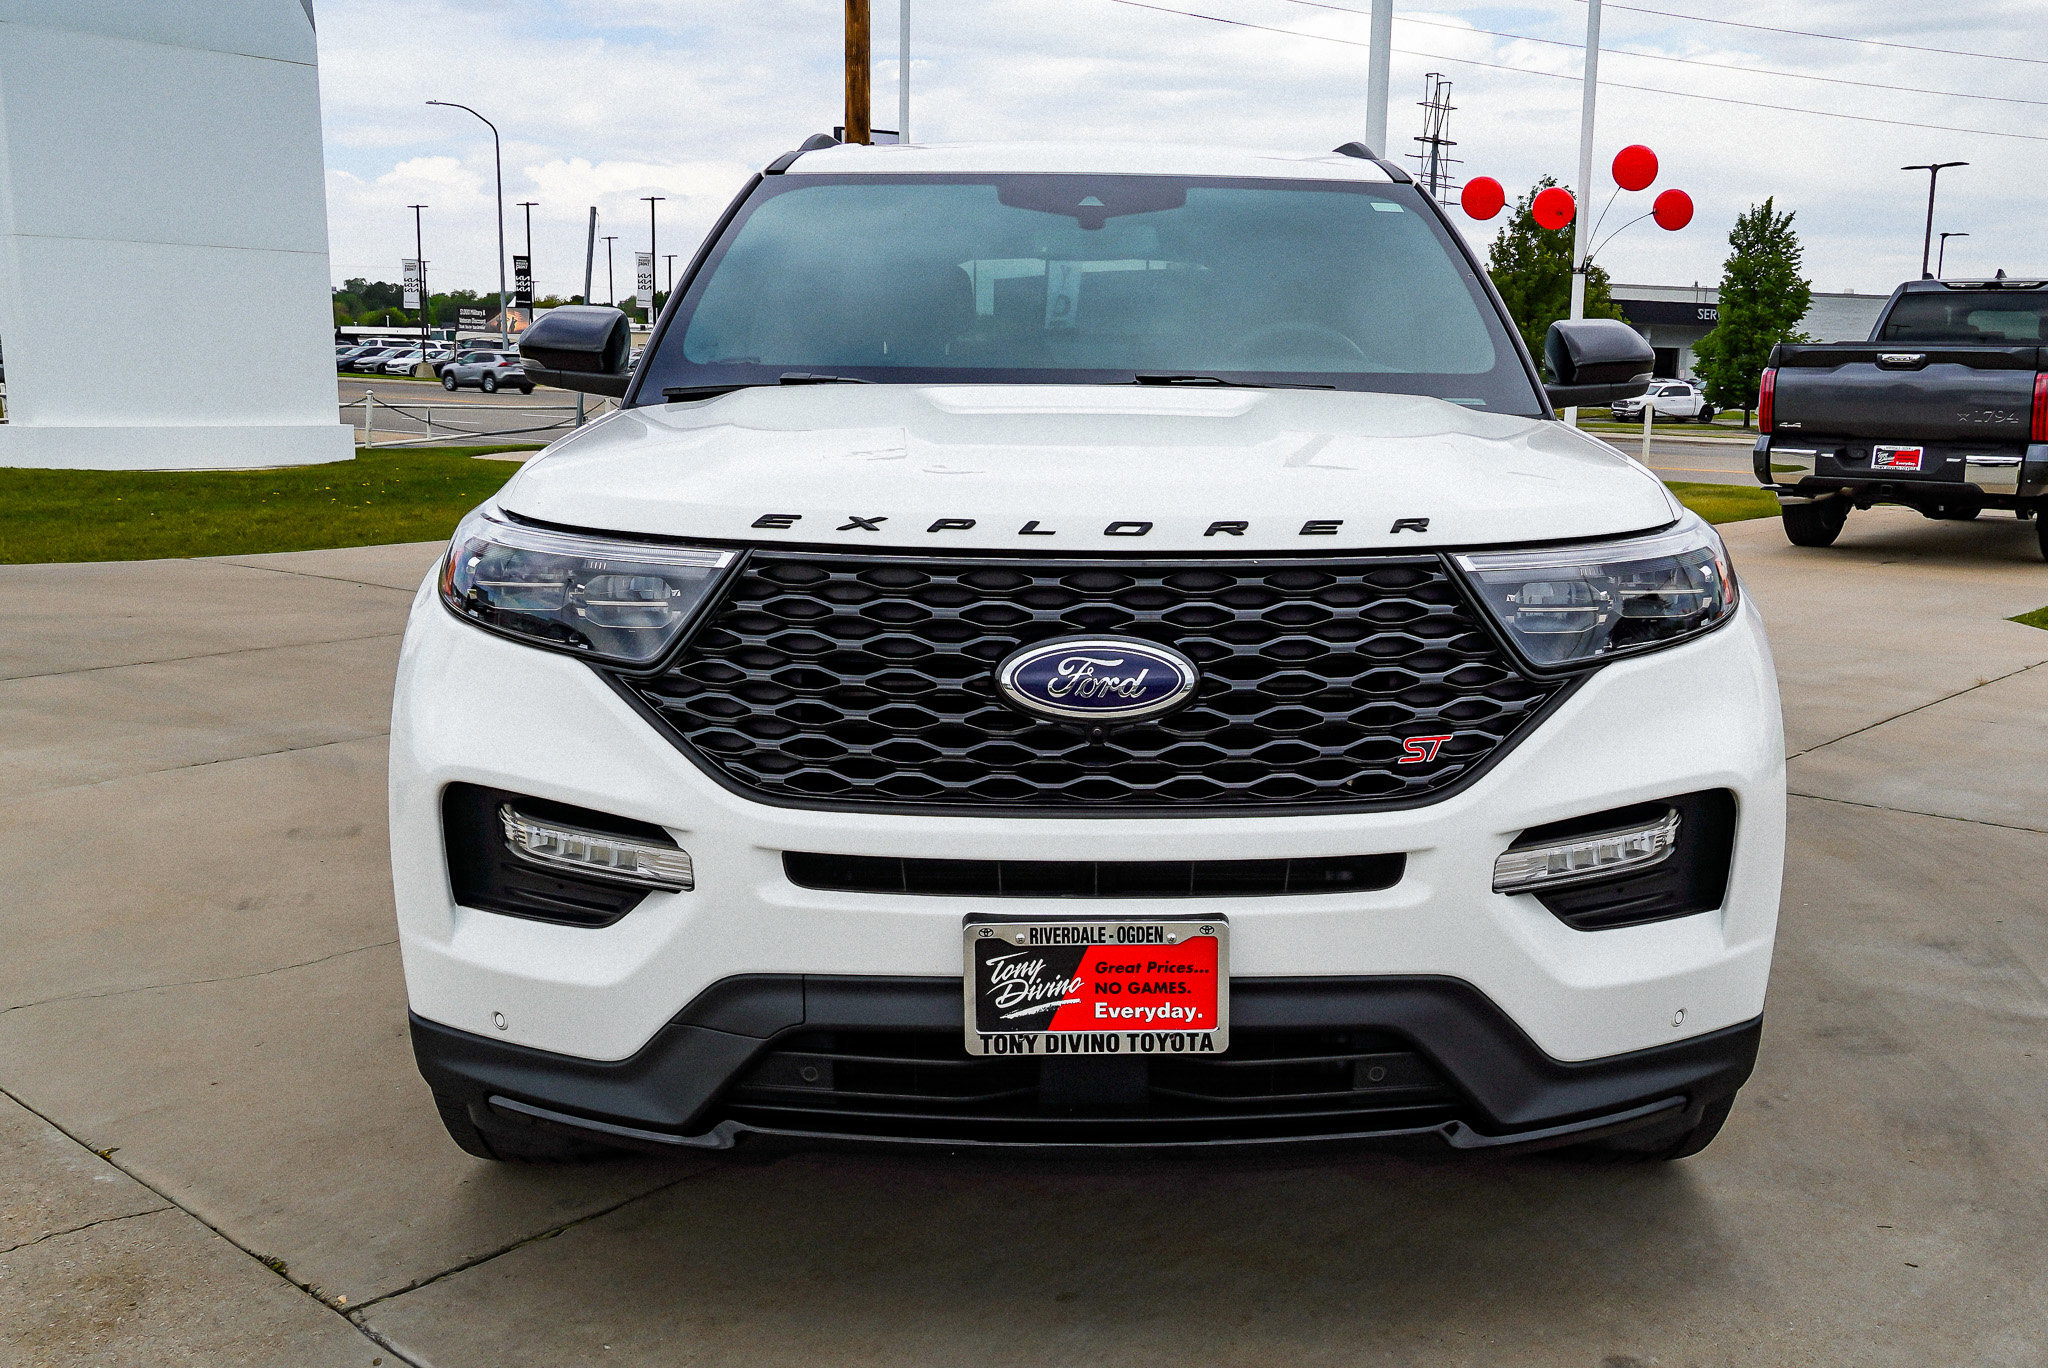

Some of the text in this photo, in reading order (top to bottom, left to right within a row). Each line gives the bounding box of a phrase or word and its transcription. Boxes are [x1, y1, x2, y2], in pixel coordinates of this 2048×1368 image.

[1974, 410, 2019, 424] 1794
[751, 513, 1430, 537] EXPLORER
[1047, 656, 1149, 698] Ford
[1397, 734, 1454, 764] ST
[1029, 927, 1106, 945] RIVERDALE
[1116, 926, 1164, 944] OGDEN
[986, 951, 1047, 985] Tony
[1095, 961, 1210, 974] Great Prices...
[985, 974, 1085, 1009] Divino
[1095, 981, 1192, 995] NO GAMES.
[1094, 1002, 1203, 1023] Everyday.
[979, 1032, 1215, 1054] TONY DIVINO TOYOTA
